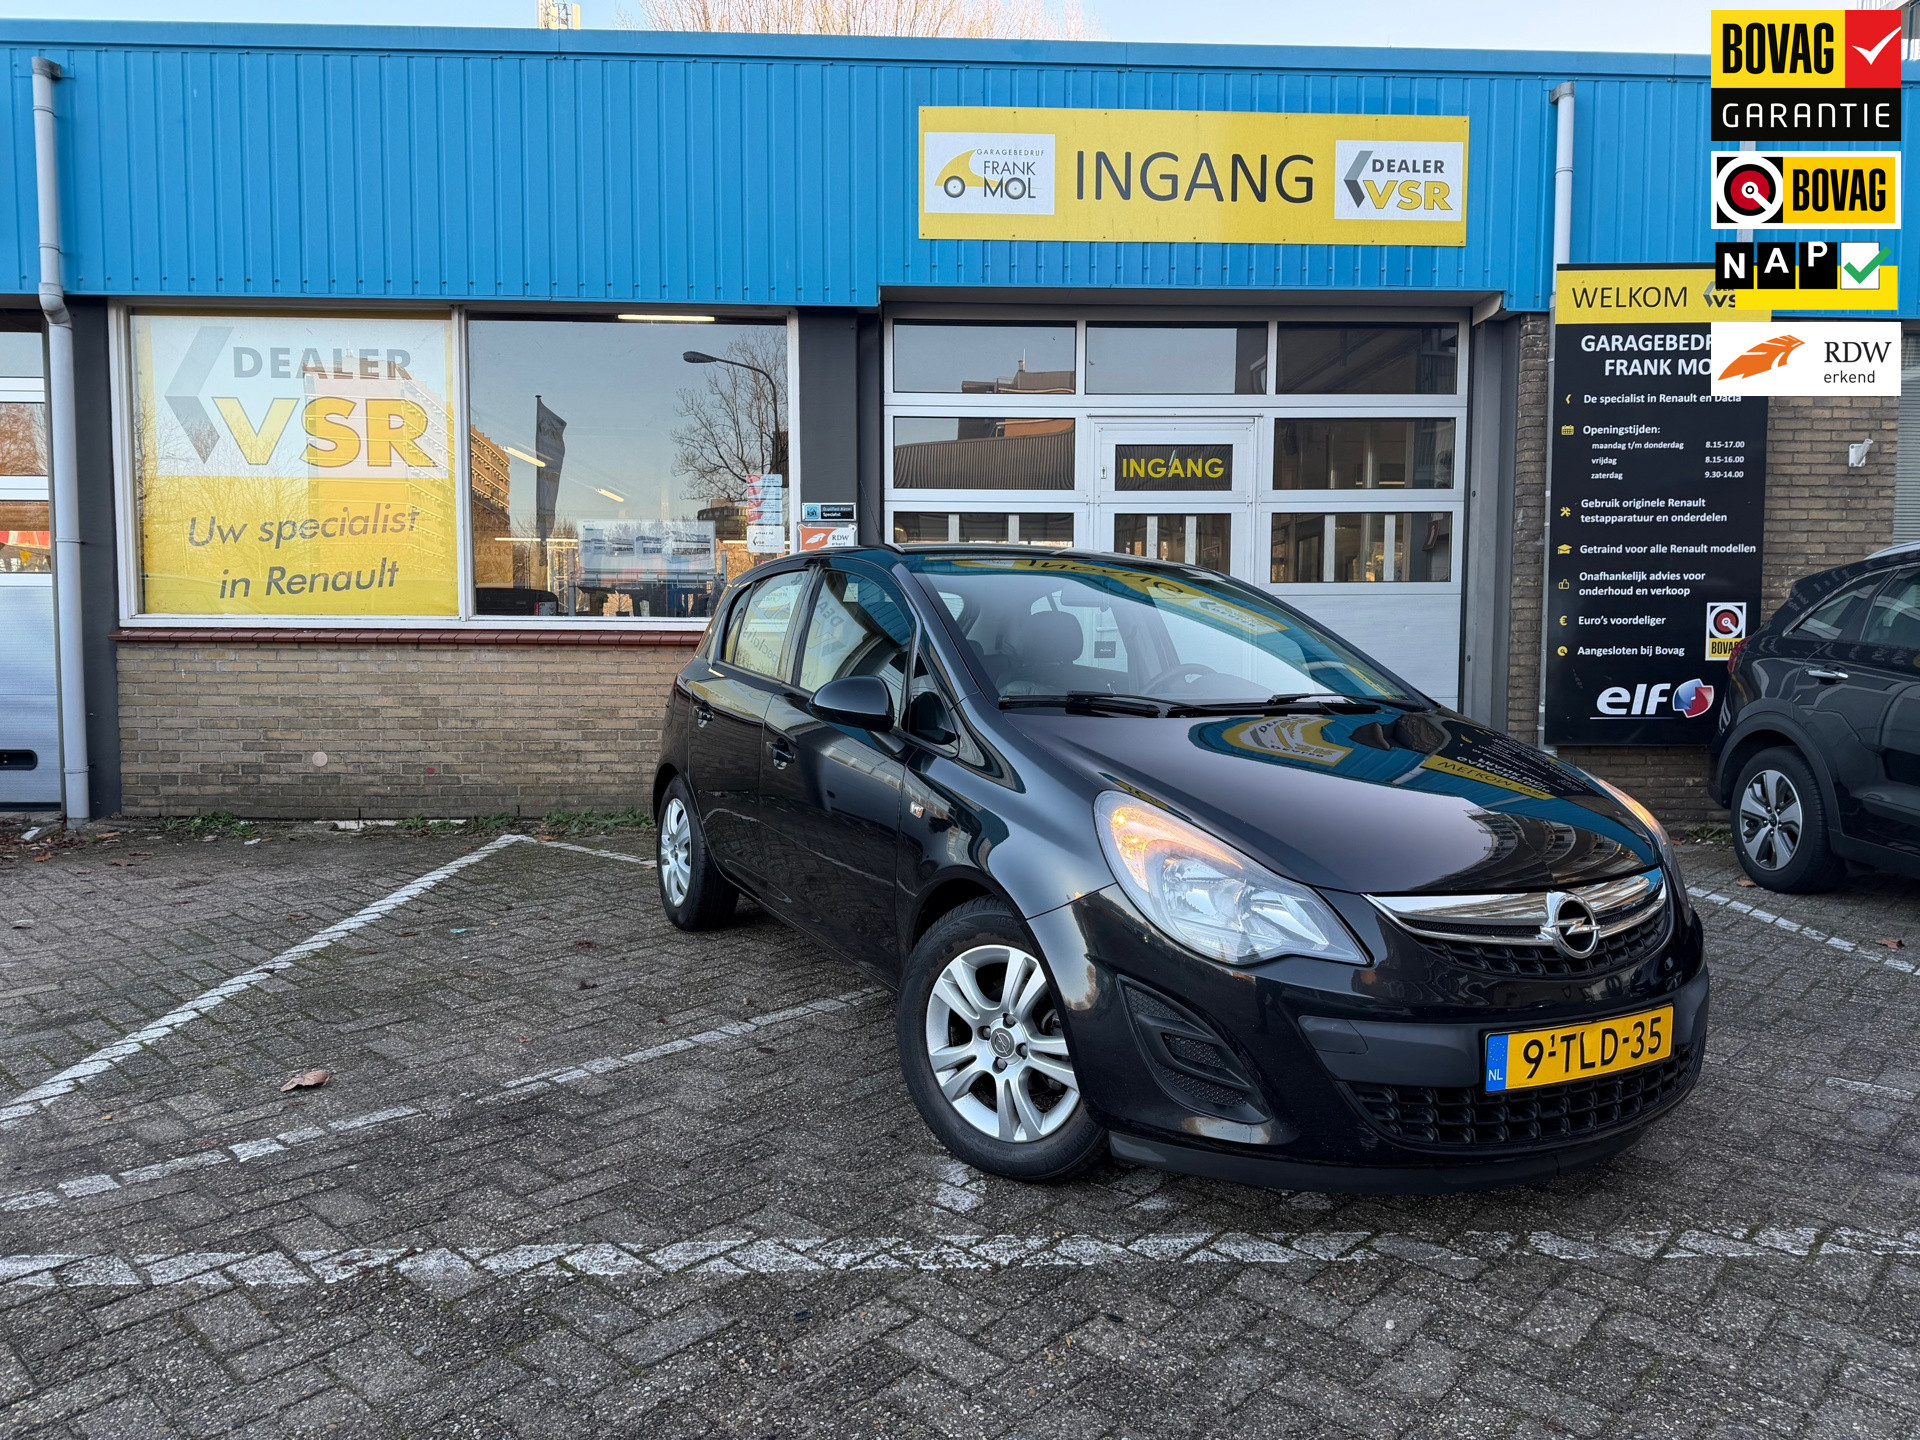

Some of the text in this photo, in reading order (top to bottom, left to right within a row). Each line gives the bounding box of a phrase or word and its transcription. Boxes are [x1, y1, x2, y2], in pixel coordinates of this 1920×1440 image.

[976, 148, 1045, 157] GARAGEBEDRIJF
[983, 160, 1036, 176] FRANK
[1371, 158, 1445, 174] DEALER
[1076, 151, 1314, 204] INGANG
[983, 176, 1036, 200] MOL
[1363, 179, 1453, 211] VSR
[1572, 286, 1688, 309] WELKOM
[1712, 294, 1736, 308] VS
[233, 346, 412, 380] DEALER
[1604, 358, 1711, 376] FRANK MO
[1583, 394, 1598, 403] De
[1599, 393, 1645, 405] specialist
[1647, 394, 1657, 403] in
[1659, 393, 1698, 403] Renault
[1699, 395, 1712, 403] en
[212, 396, 439, 468] VSR
[1582, 424, 1661, 436] Openingstijden:
[1591, 441, 1684, 450] maandag t/m donderdag
[1122, 457, 1225, 478] INGANG
[1591, 457, 1618, 466] vrijdag
[1590, 471, 1624, 480] zaterdag
[1704, 470, 1744, 478] 9.30-14.00
[1581, 498, 1706, 510] Gebruik originele Renault
[1580, 513, 1728, 525] testapparatuur en onderdelen
[188, 503, 420, 549] Uw specialist
[1579, 543, 1757, 554] Getraind voor alle Renault modellen
[219, 557, 400, 599] in Renault
[1579, 571, 1706, 583] Onafhankelijk advies voor
[1578, 586, 1691, 597] onderhoud en verkoop
[1578, 615, 1666, 627] Euro's voordeliger
[1577, 645, 1685, 657] Aangesloten bij Bovag
[1711, 641, 1738, 654] BOVA
[1596, 683, 1671, 715] elf
[1488, 1069, 1503, 1081] NL
